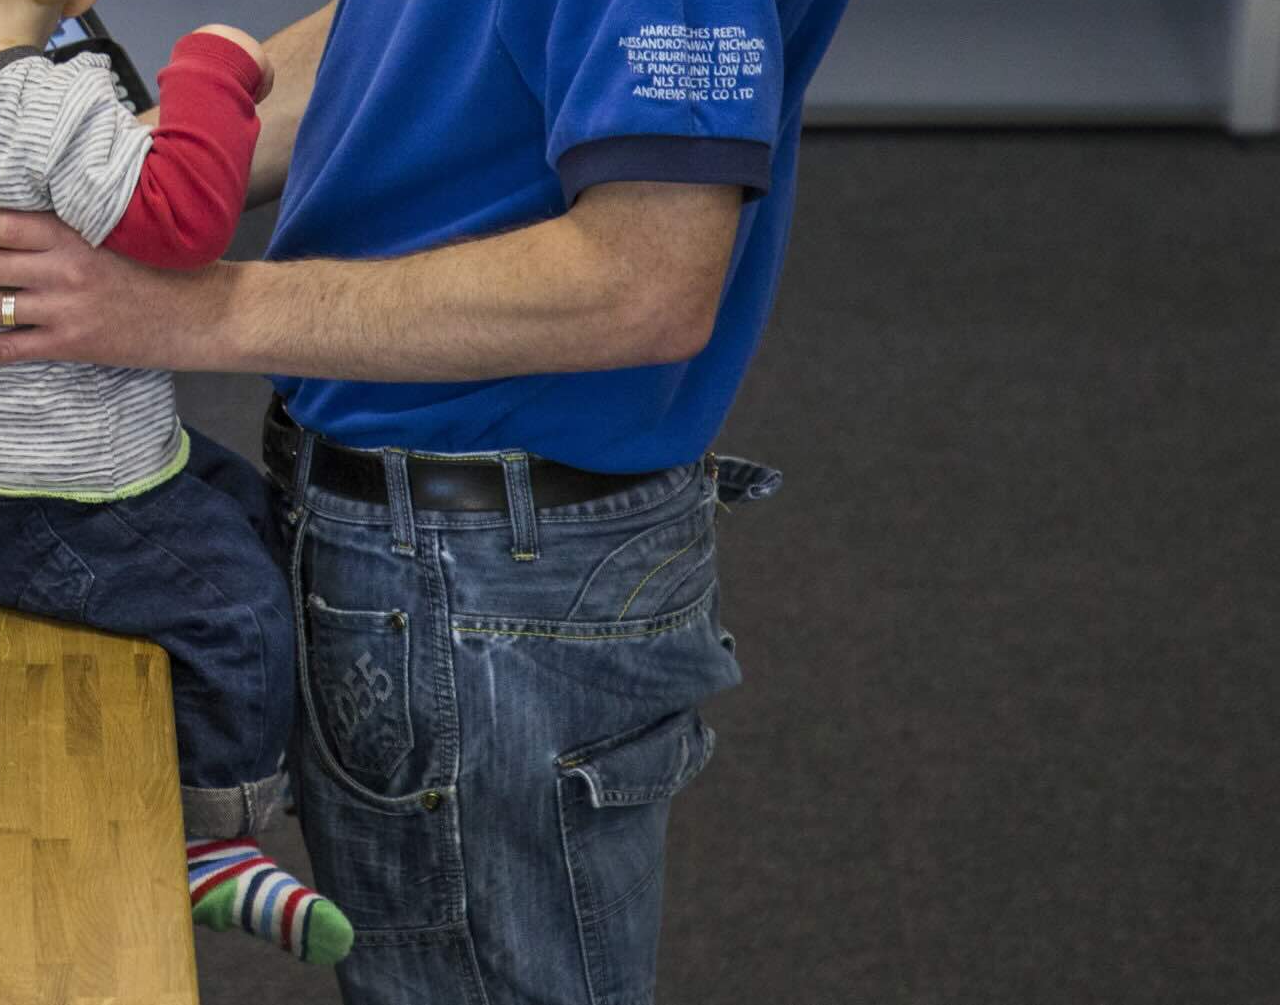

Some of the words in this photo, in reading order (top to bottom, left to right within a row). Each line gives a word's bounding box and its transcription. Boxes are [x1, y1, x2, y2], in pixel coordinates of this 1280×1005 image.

[713, 26, 746, 38] REETH
[687, 52, 714, 64] HALL
[718, 51, 740, 64] (NE)
[744, 51, 761, 63] LTD
[648, 62, 685, 75] PUNCH
[689, 64, 709, 77] INN
[714, 65, 739, 77] LOW
[653, 75, 673, 87] NLS
[714, 77, 736, 88] LTD
[633, 85, 686, 100] ANDREWS
[712, 88, 729, 100] CO
